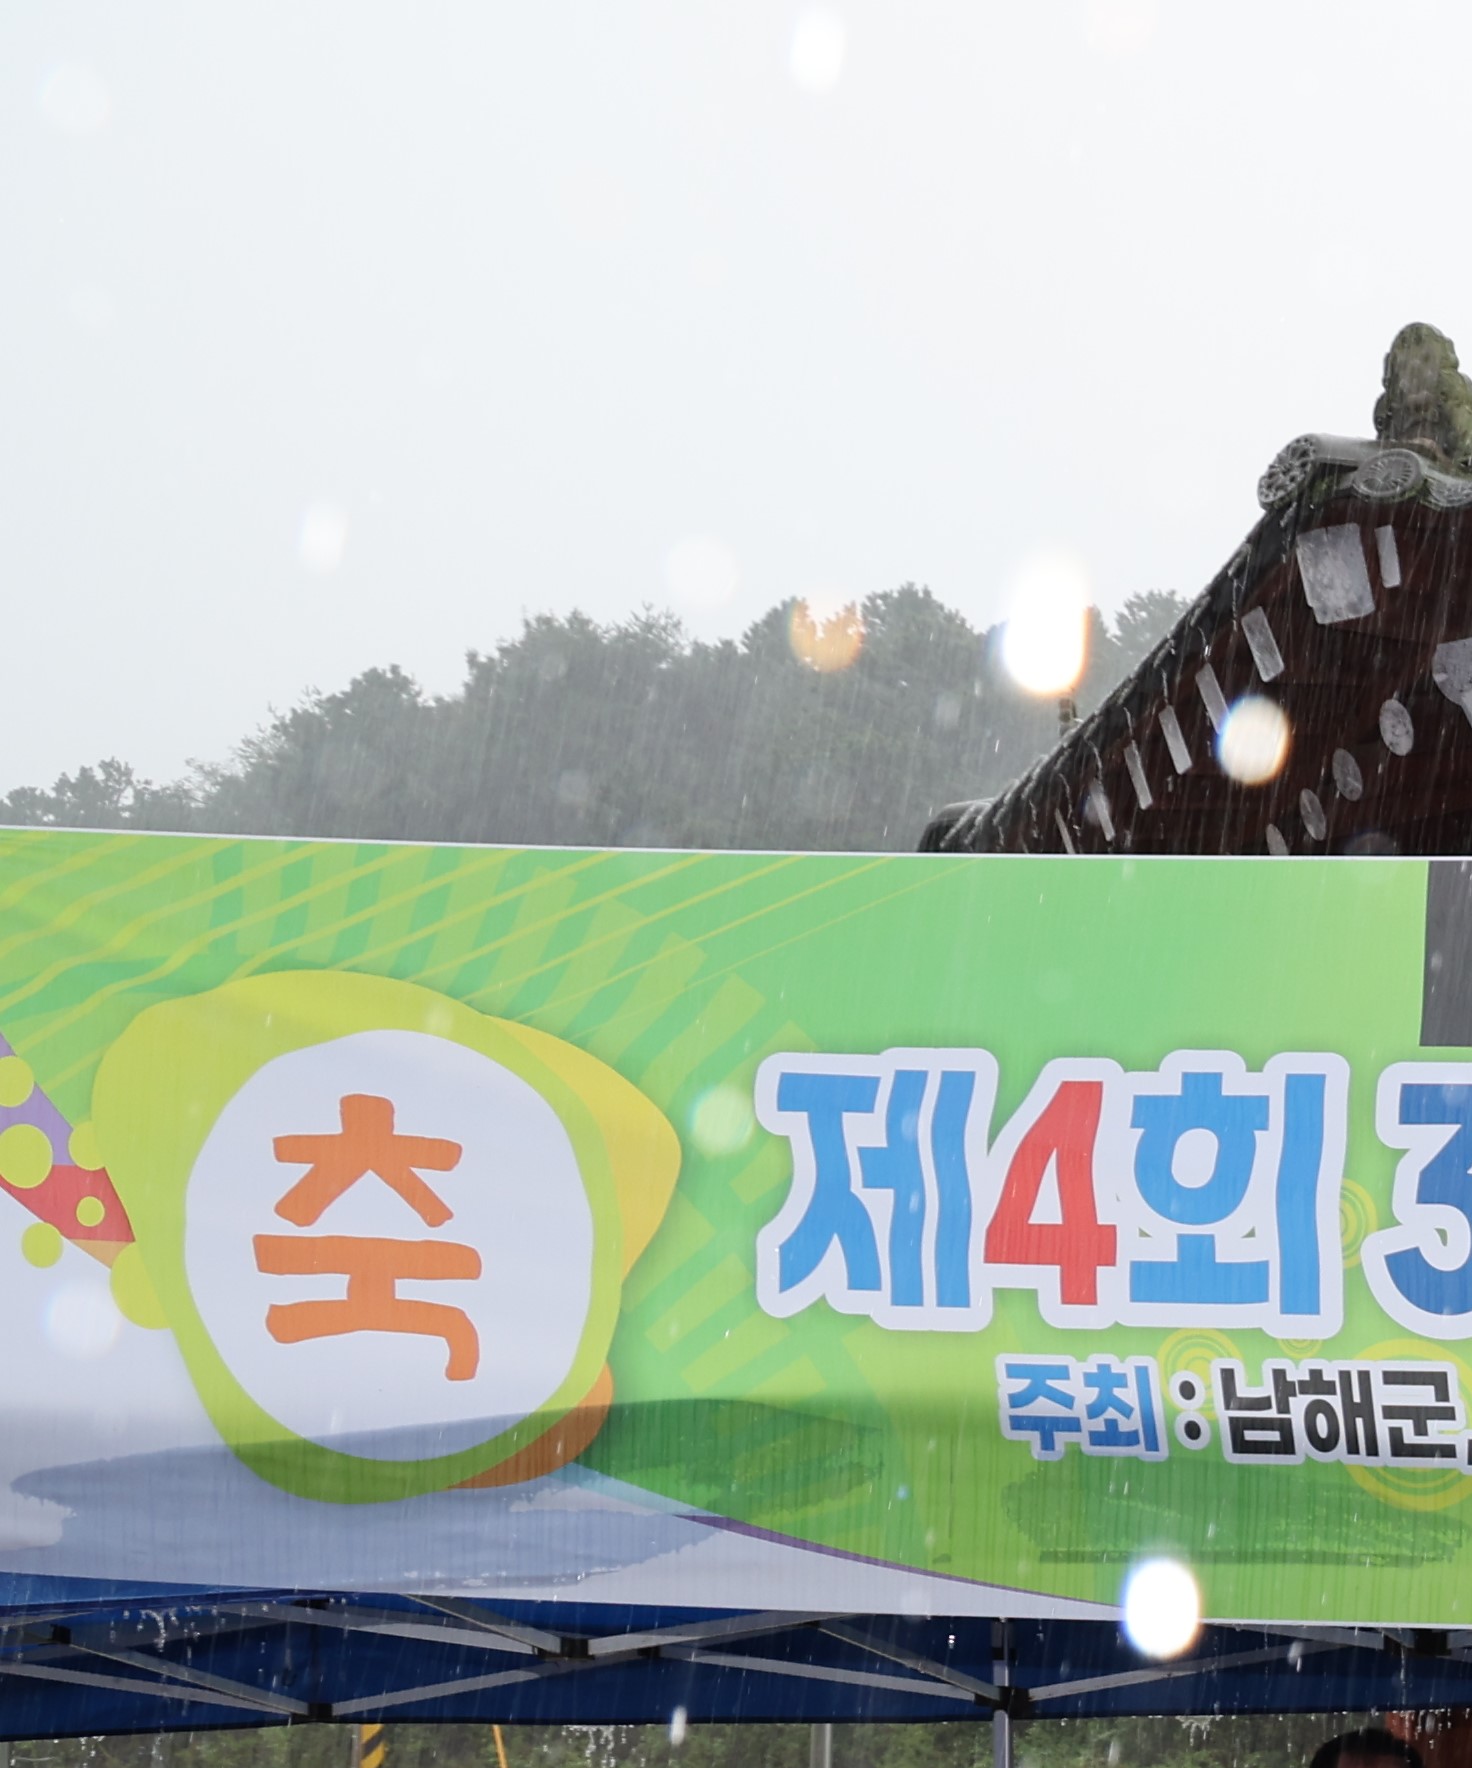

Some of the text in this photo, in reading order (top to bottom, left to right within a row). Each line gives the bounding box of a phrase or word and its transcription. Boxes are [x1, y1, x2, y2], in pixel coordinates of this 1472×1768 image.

[255, 1094, 481, 1381] 축
[776, 1069, 1326, 1316] 제4회
[1005, 1362, 1160, 1453] 주최
